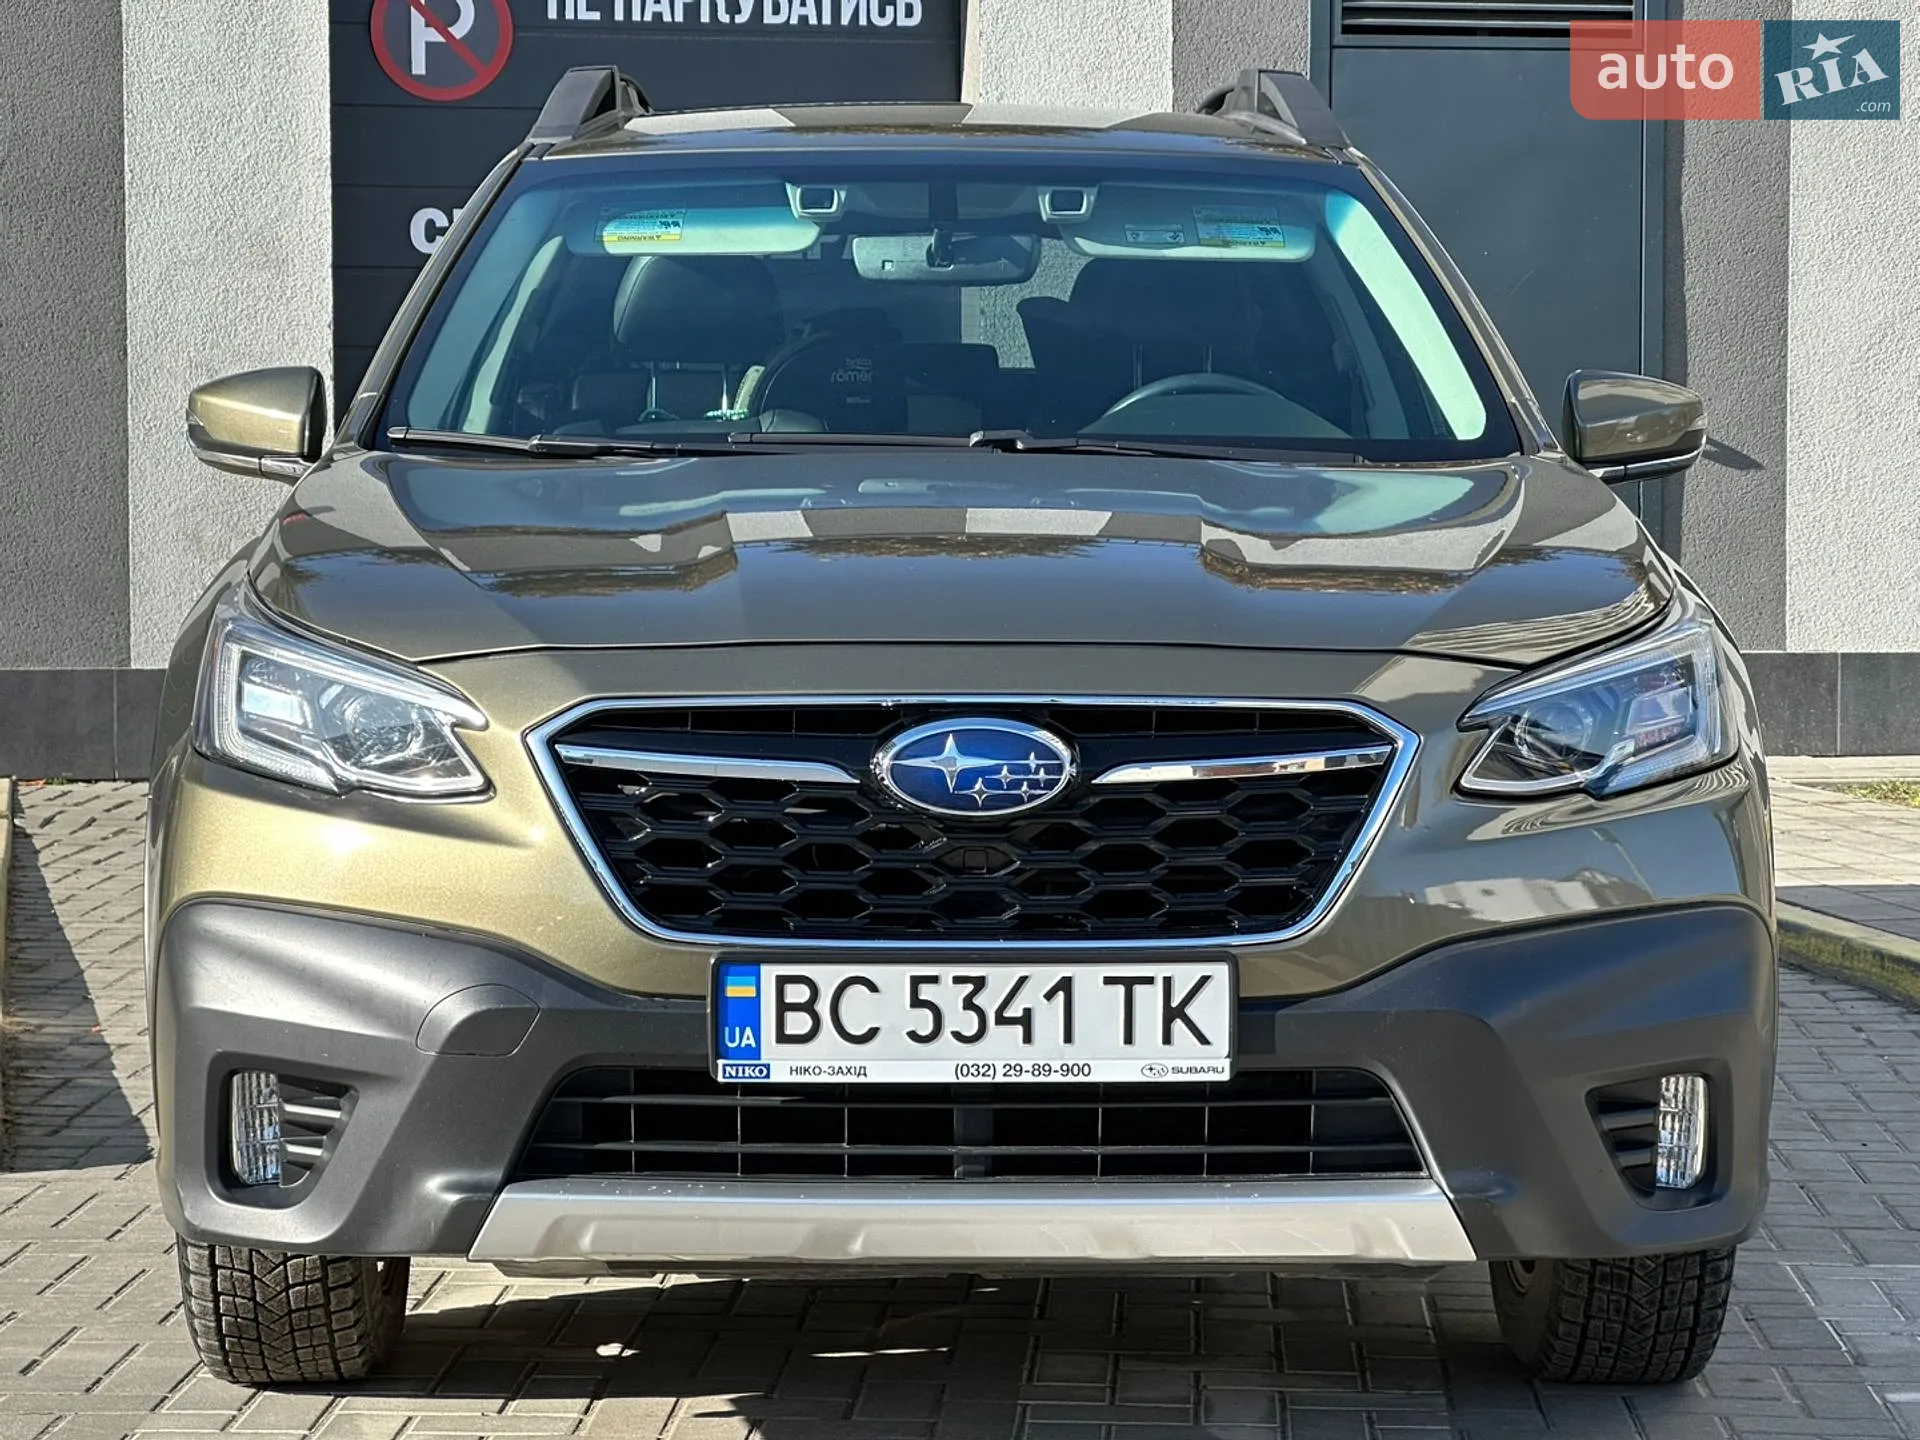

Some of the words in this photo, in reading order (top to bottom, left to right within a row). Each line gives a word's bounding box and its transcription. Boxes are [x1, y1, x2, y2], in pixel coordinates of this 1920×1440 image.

[774, 974, 881, 1045] BC
[905, 974, 1073, 1045] 5341
[1102, 974, 1213, 1046] TK
[724, 1026, 757, 1048] UA
[723, 1065, 768, 1078] NIKO
[789, 1065, 868, 1077] НІКО-ЗАХІД
[954, 1063, 997, 1081] (032)
[1002, 1063, 1092, 1078] 29-89-900
[1171, 1066, 1226, 1075] SUBARU
